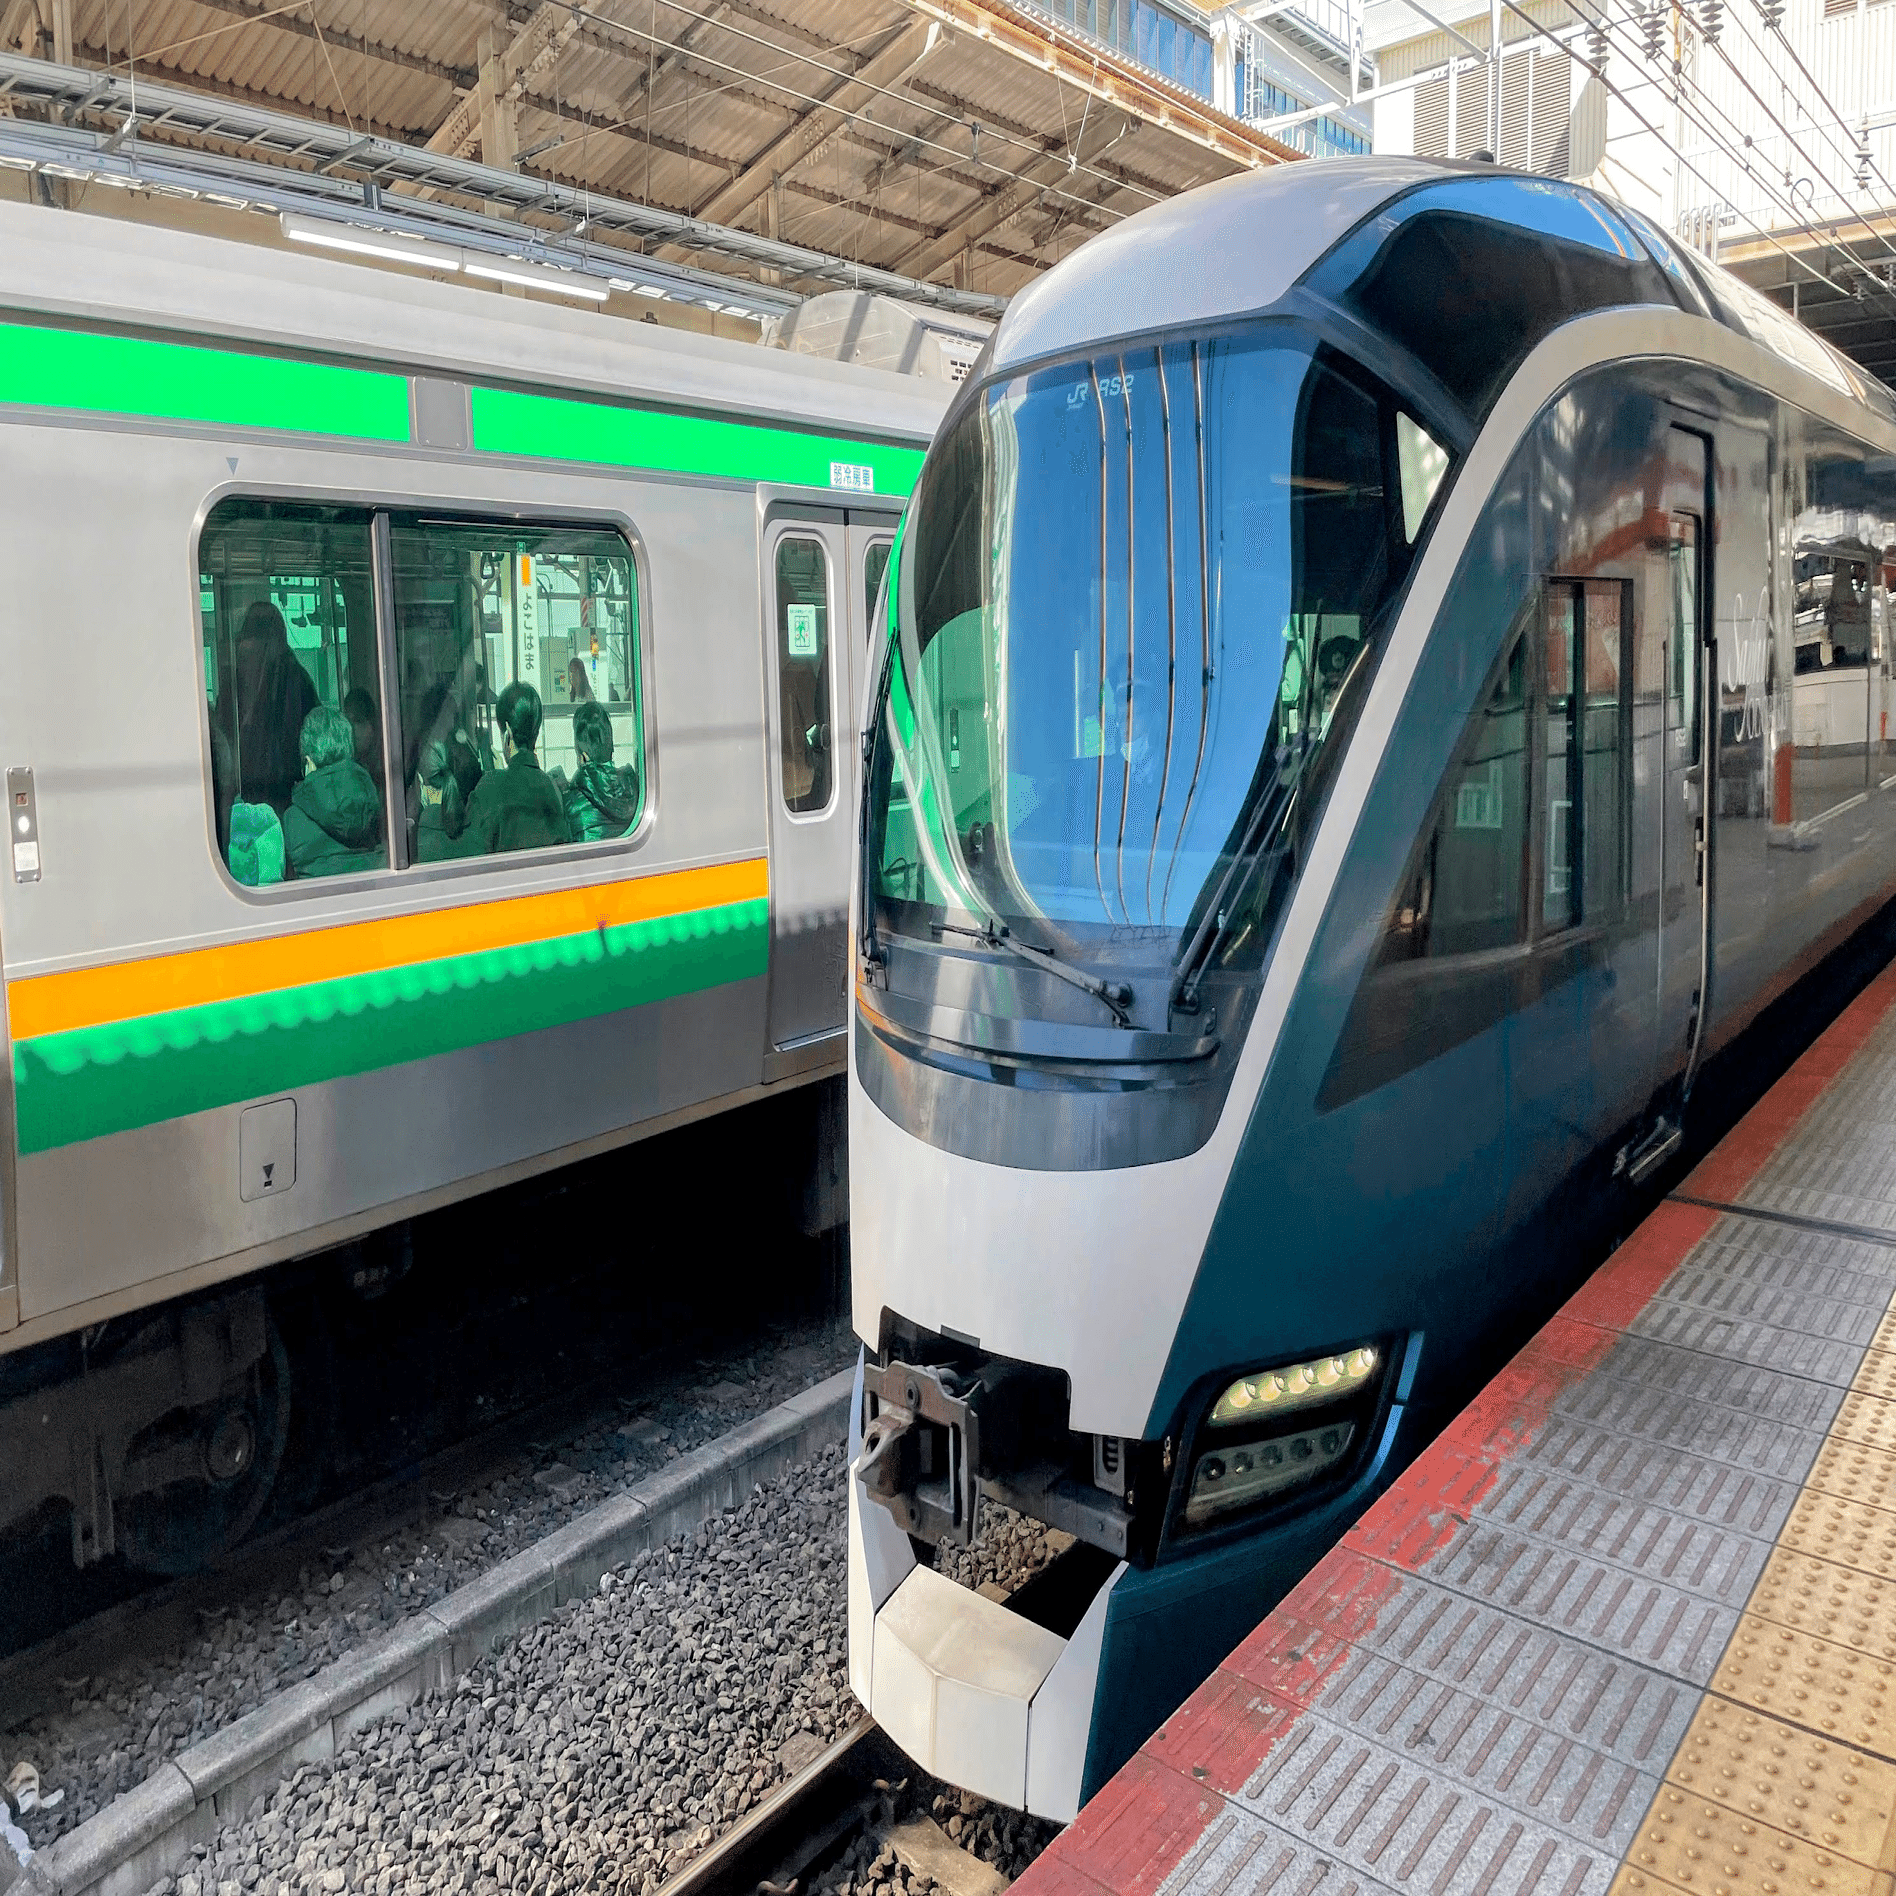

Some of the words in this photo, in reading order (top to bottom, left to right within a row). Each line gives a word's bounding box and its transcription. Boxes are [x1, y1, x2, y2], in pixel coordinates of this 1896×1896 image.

[1067, 382, 1088, 403] JR
[833, 464, 871, 486] 弱冷房車
[523, 592, 535, 671] よこはま
